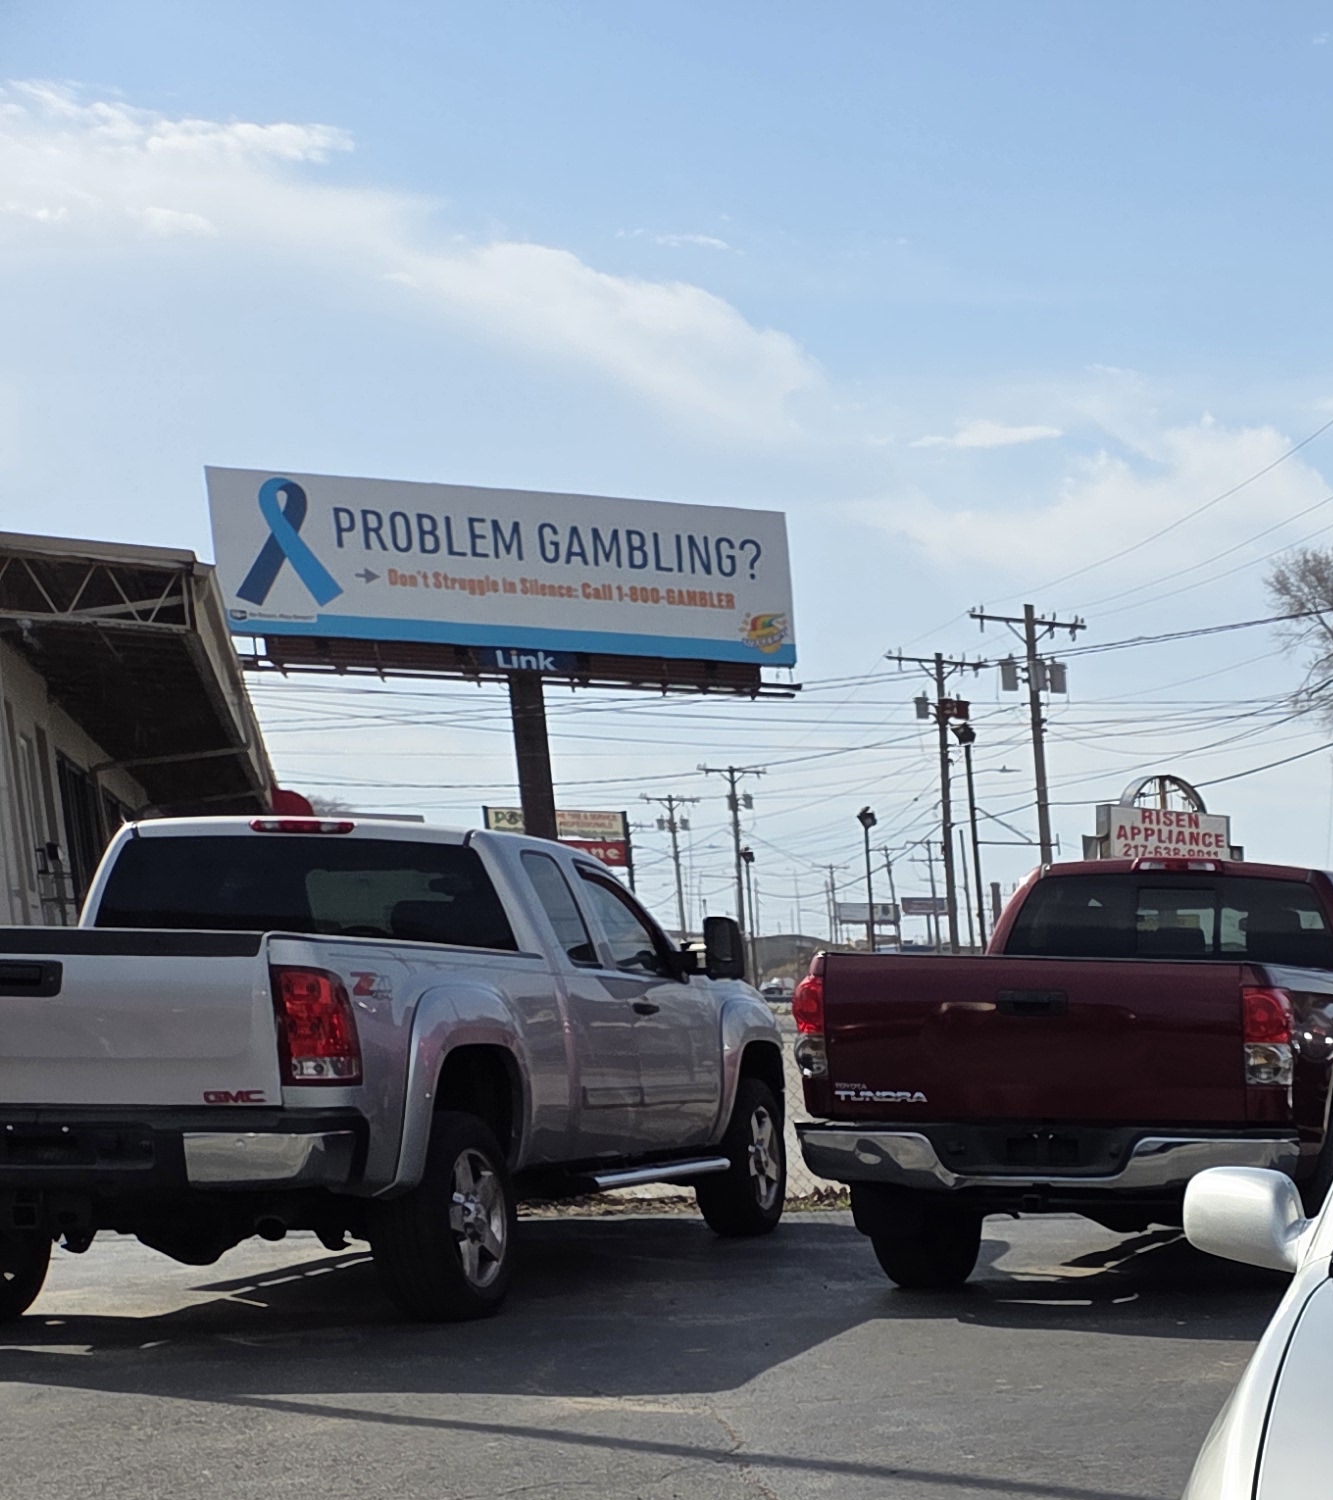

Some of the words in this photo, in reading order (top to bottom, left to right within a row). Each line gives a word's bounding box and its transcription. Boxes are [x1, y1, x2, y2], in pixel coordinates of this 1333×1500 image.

[333, 507, 523, 561] PROBLEM
[538, 523, 762, 580] GAMBLING?
[387, 568, 430, 588] Don't
[432, 571, 499, 596] Struggle
[520, 577, 579, 598] Silence:
[581, 582, 613, 601] Call
[616, 585, 735, 609] 1-800-GAMBLER
[495, 650, 558, 671] Link
[1141, 810, 1200, 829] RISEN
[1116, 825, 1225, 849] APPLIANCE
[203, 1090, 266, 1103] GMC
[834, 1090, 928, 1103] TUNDRA
